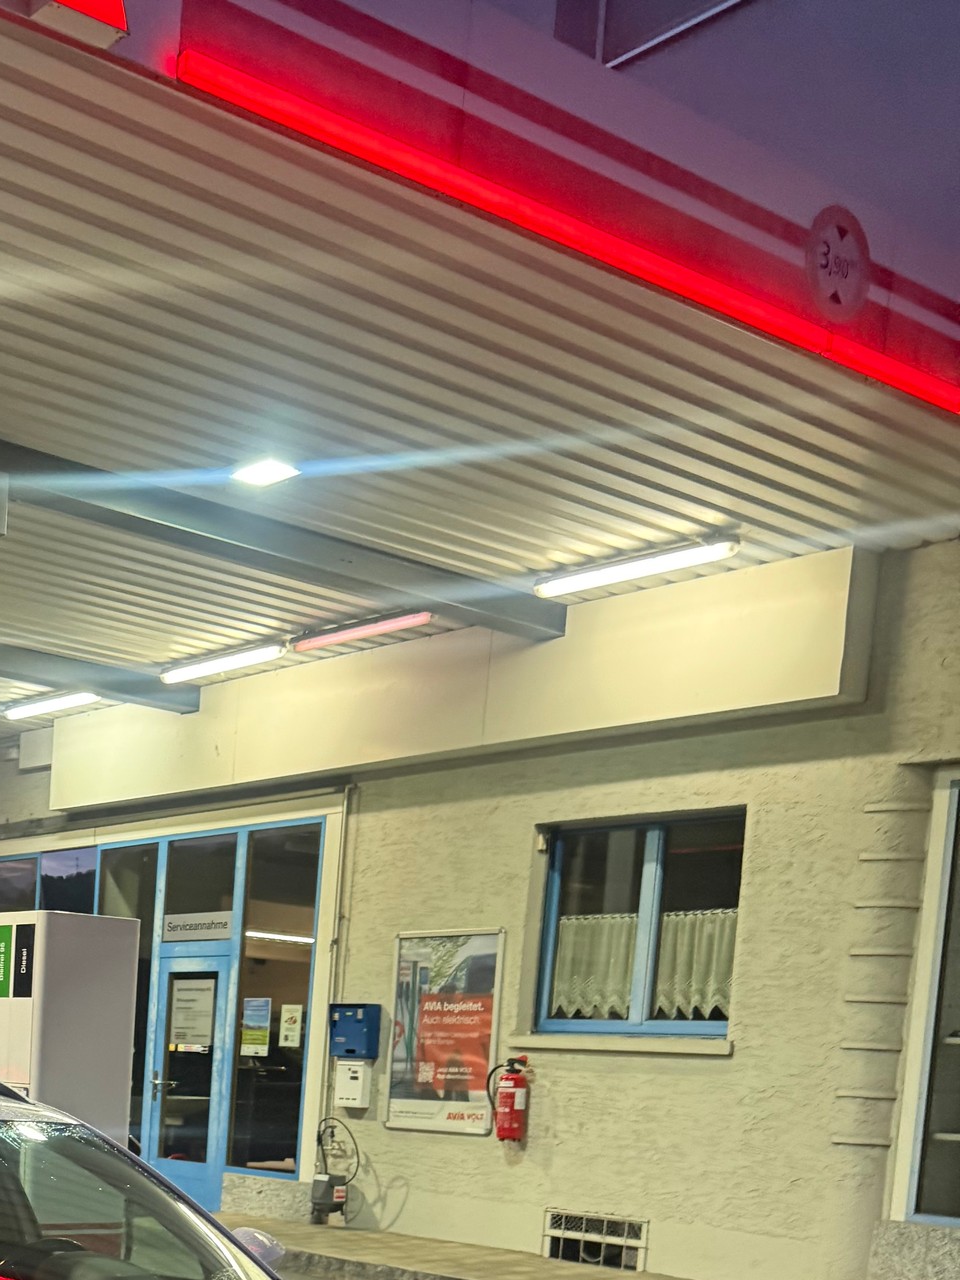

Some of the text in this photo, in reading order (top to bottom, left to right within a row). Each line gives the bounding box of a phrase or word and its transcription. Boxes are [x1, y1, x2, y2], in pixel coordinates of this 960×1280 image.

[166, 920, 228, 932] Serviceannahme
[423, 1001, 484, 1013] AVIA begleitet.
[446, 1112, 465, 1121] AVIA
